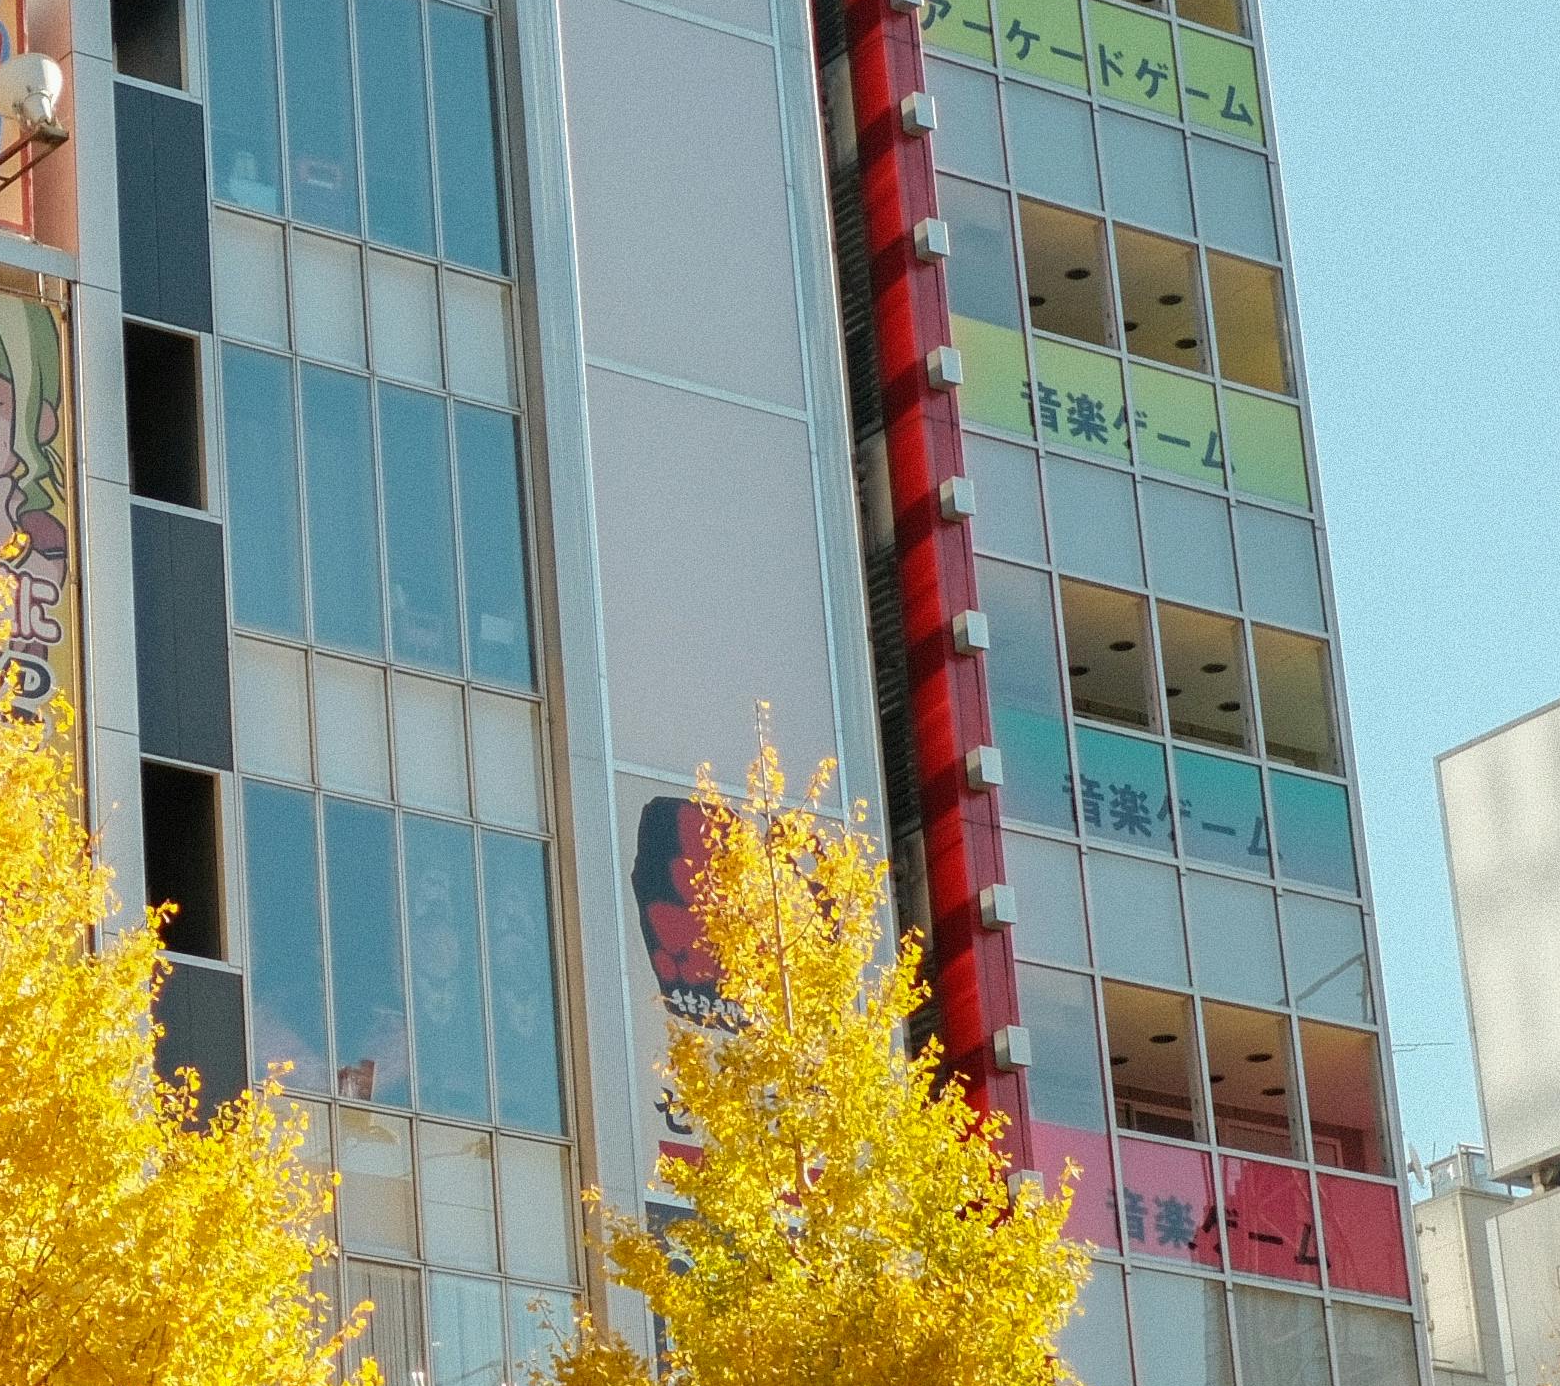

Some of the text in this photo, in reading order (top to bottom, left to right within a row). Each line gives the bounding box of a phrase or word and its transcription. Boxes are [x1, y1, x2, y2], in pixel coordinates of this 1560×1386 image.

[1020, 380, 1237, 474] 音楽ゲーム
[1062, 772, 1284, 861] 音楽ゲーム
[1104, 1185, 1331, 1269] 音楽ゲーム
